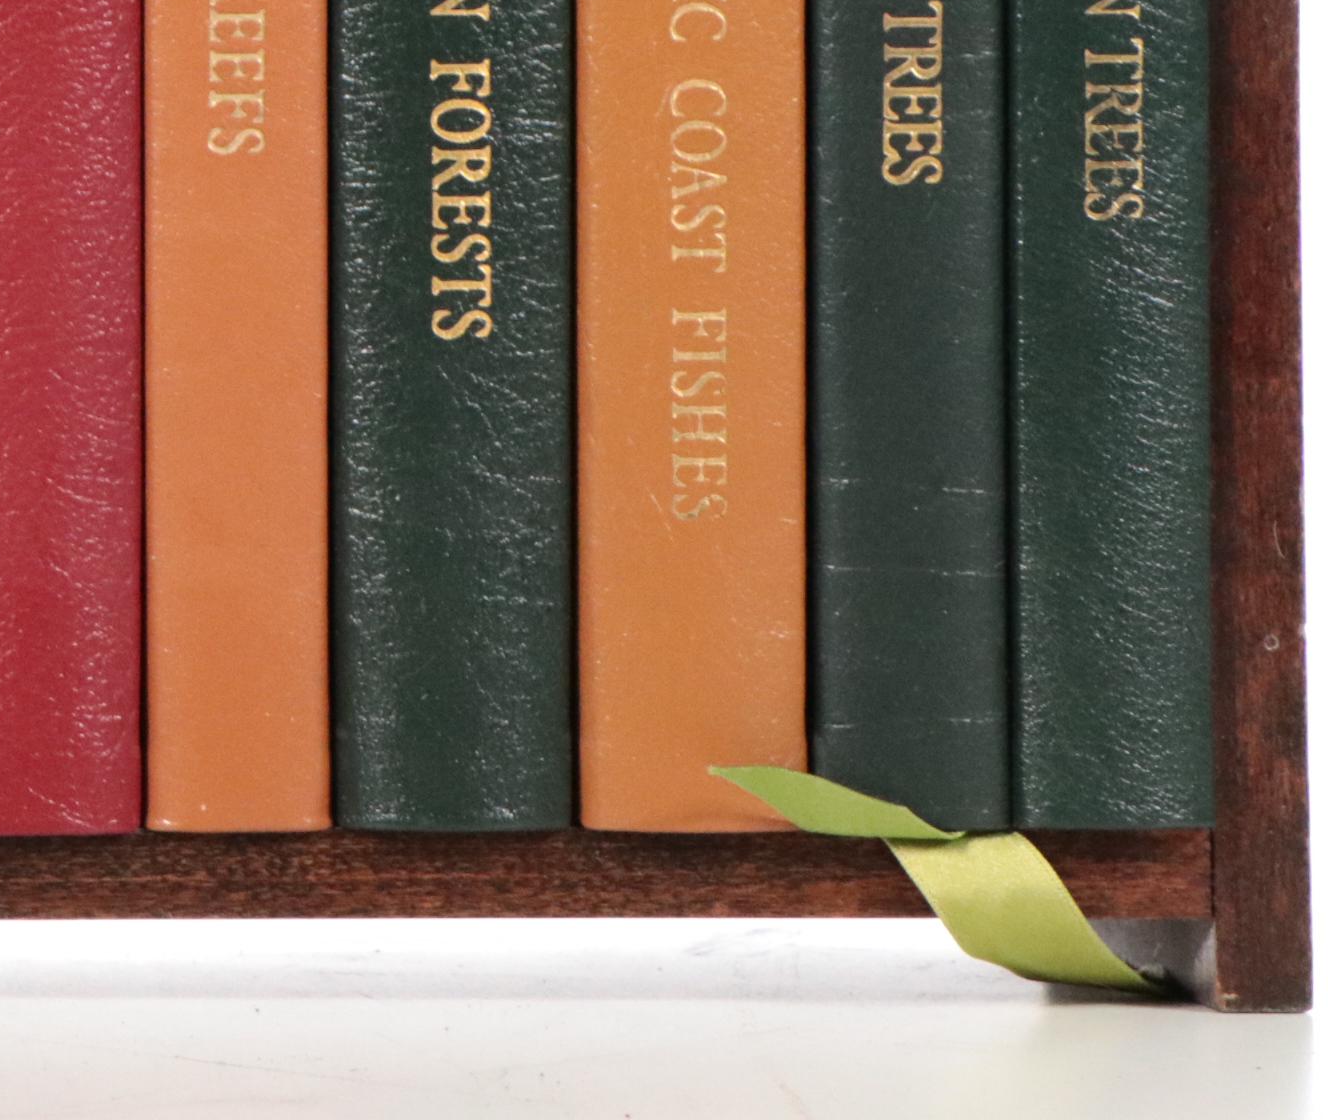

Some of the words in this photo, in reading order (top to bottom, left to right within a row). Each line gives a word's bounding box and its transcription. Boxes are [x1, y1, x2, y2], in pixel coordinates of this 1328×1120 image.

[669, 77, 728, 272] COAST
[882, 0, 943, 188] TREES
[1084, 38, 1143, 223] TREES
[429, 58, 493, 341] FORESTS
[670, 307, 728, 523] FISHES
